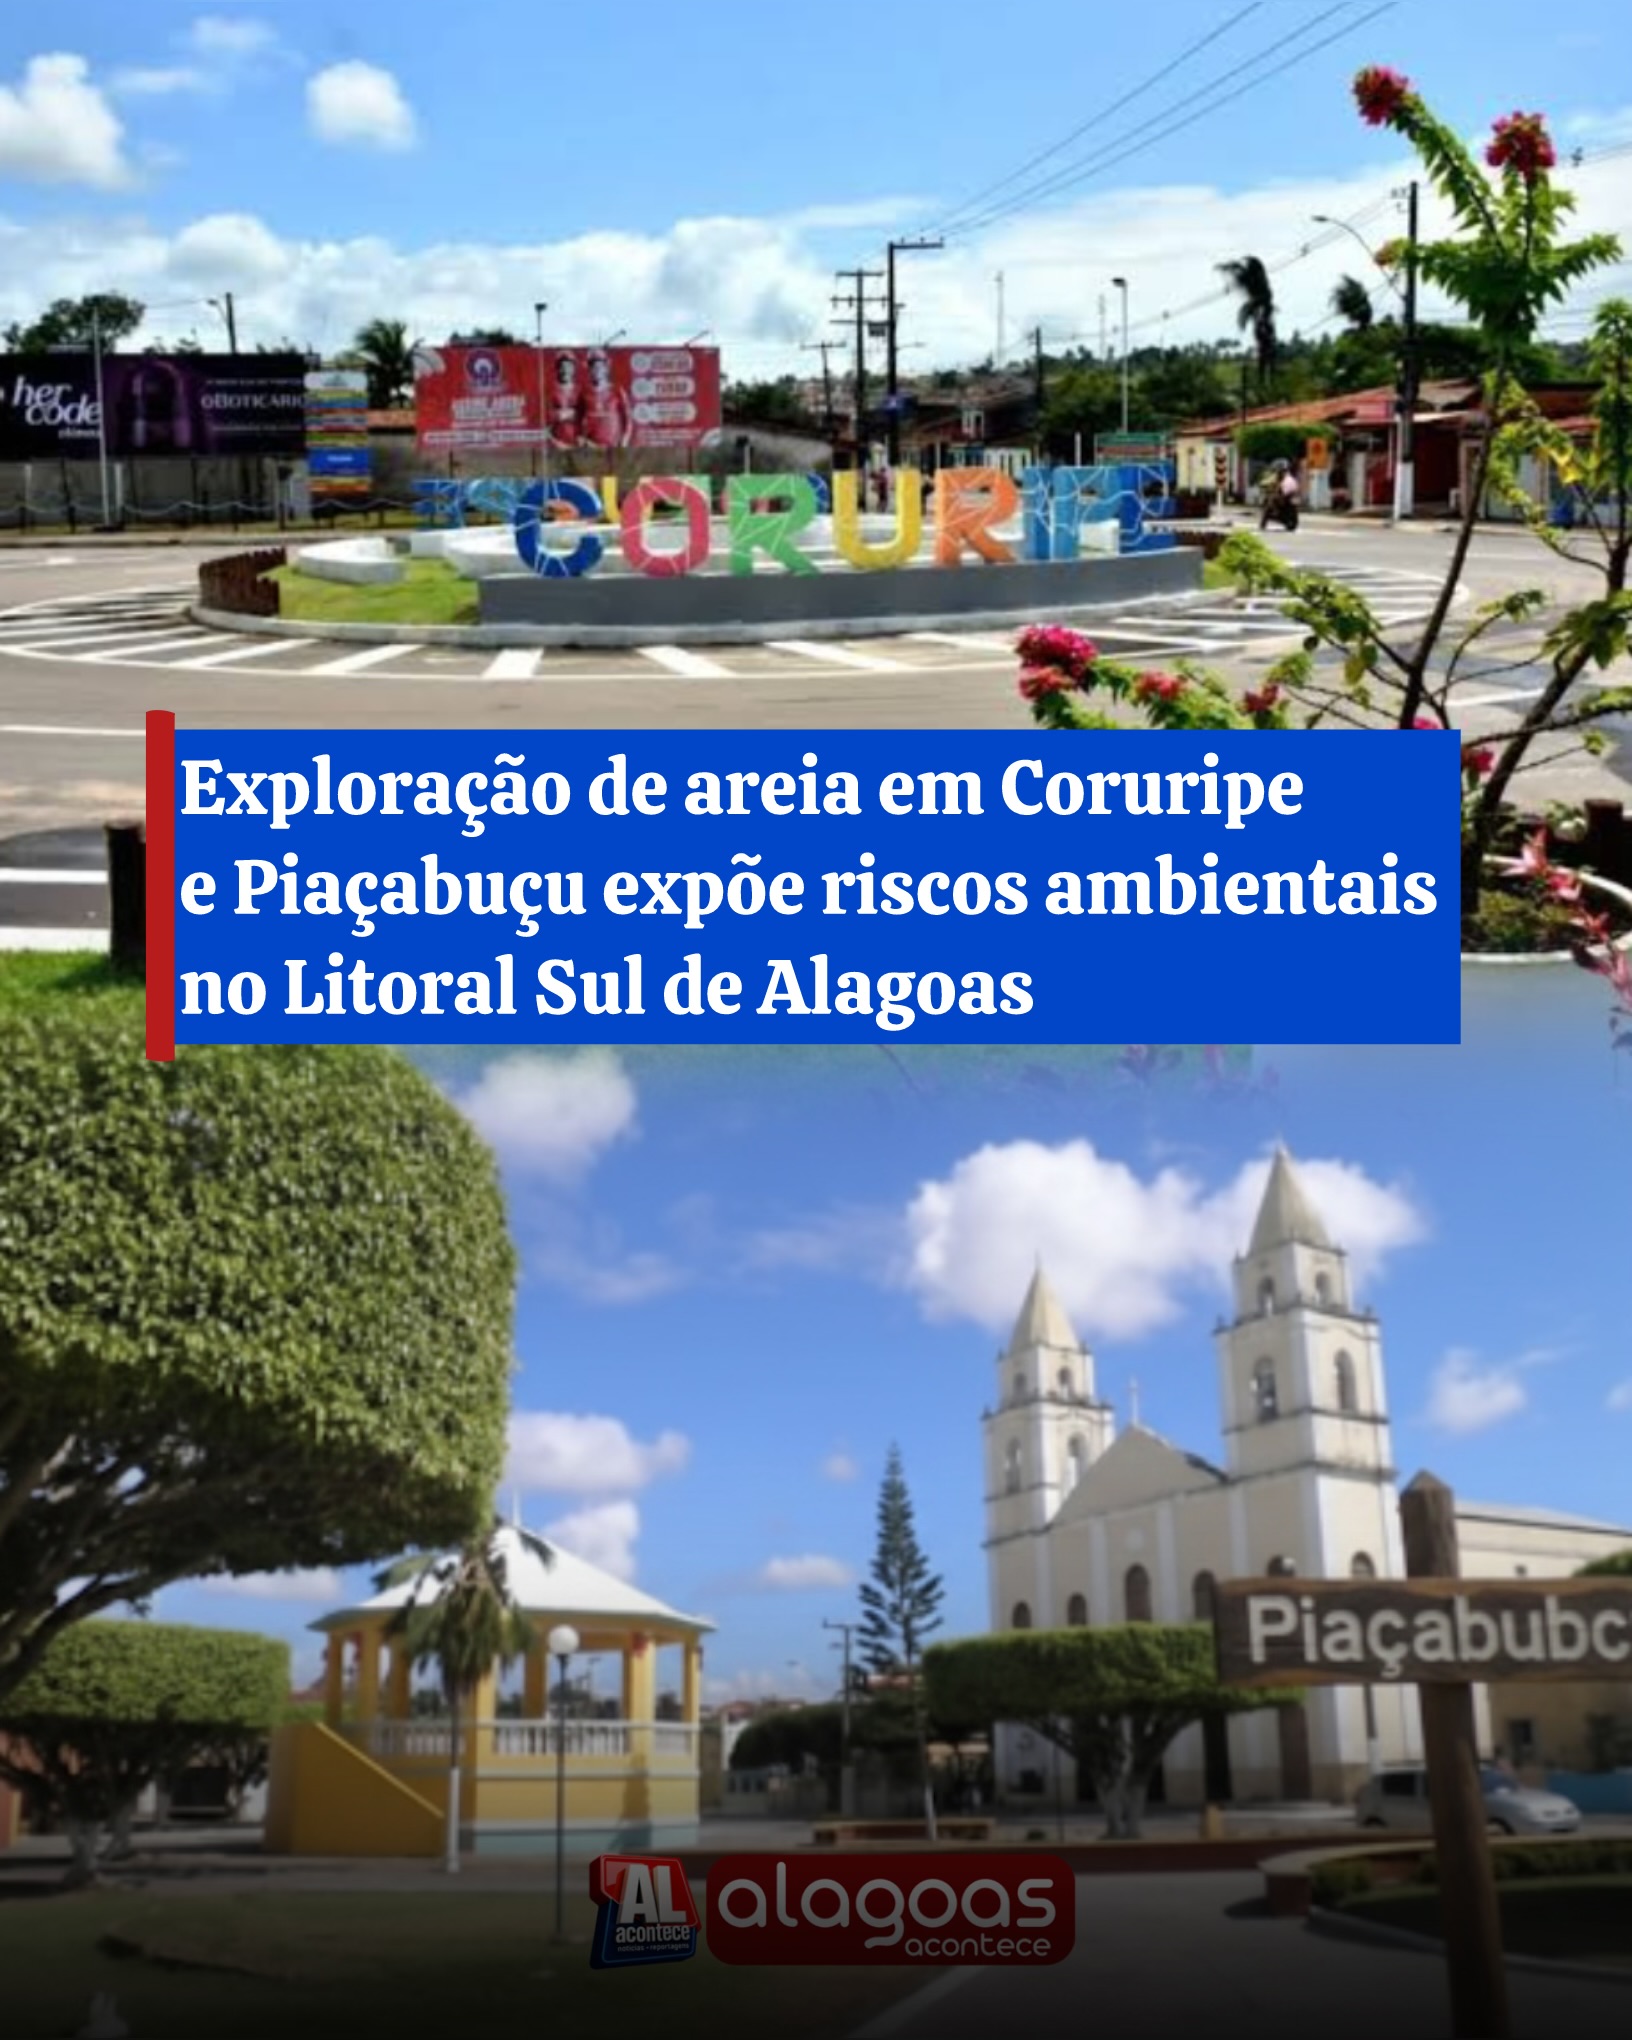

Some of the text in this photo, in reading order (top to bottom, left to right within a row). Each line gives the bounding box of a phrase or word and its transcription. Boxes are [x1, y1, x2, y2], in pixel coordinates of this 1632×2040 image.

[12, 375, 72, 406] her
[25, 394, 101, 425] code
[515, 464, 1175, 578] CORURIPE
[1247, 1595, 1632, 1679] Piaçabubc
